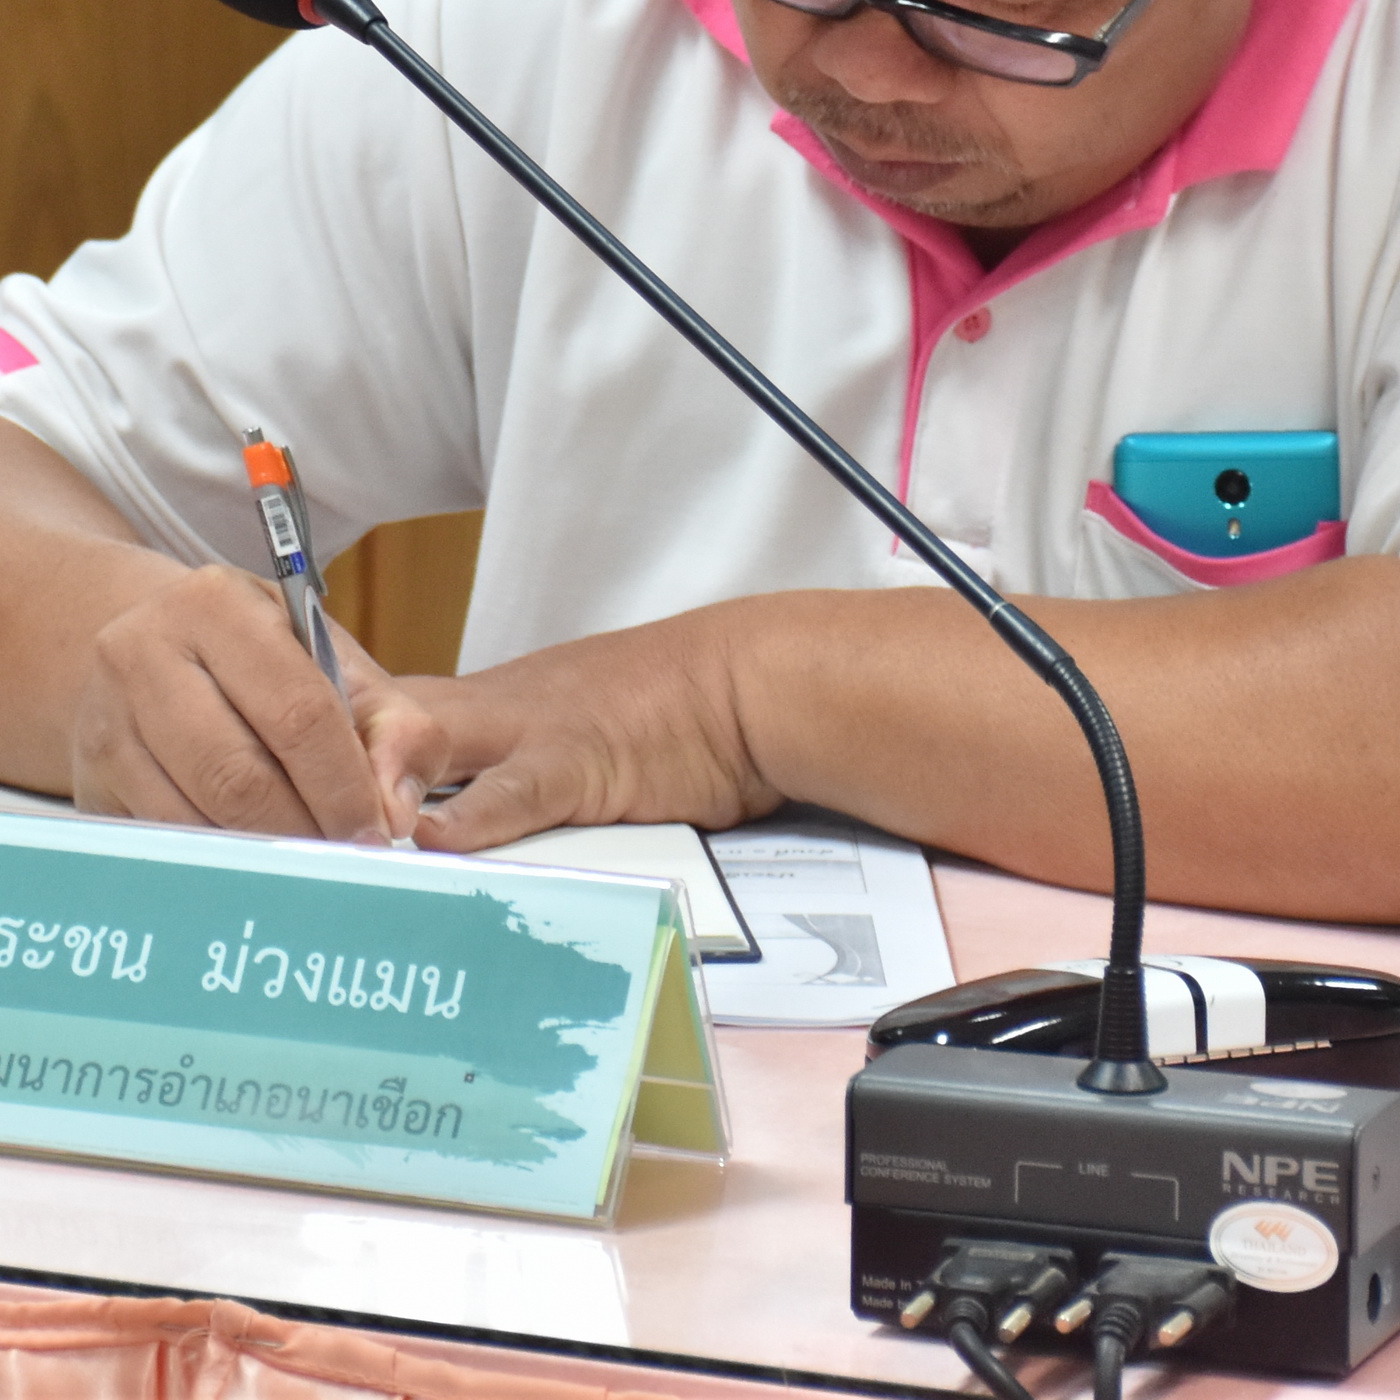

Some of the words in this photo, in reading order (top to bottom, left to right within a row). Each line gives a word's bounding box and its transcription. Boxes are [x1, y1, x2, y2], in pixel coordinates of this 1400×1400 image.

[201, 919, 467, 1020] ม่วงแมน
[859, 1152, 948, 1171] PROFESSIONAL
[1078, 1161, 1111, 1178] LINE
[1222, 1150, 1340, 1194] NPE
[859, 1166, 940, 1184] CONFERENCE
[944, 1173, 992, 1189] SYSTEM
[1222, 1182, 1340, 1205] RESEARCH
[861, 1273, 896, 1291] Made
[861, 1295, 894, 1310] Made
